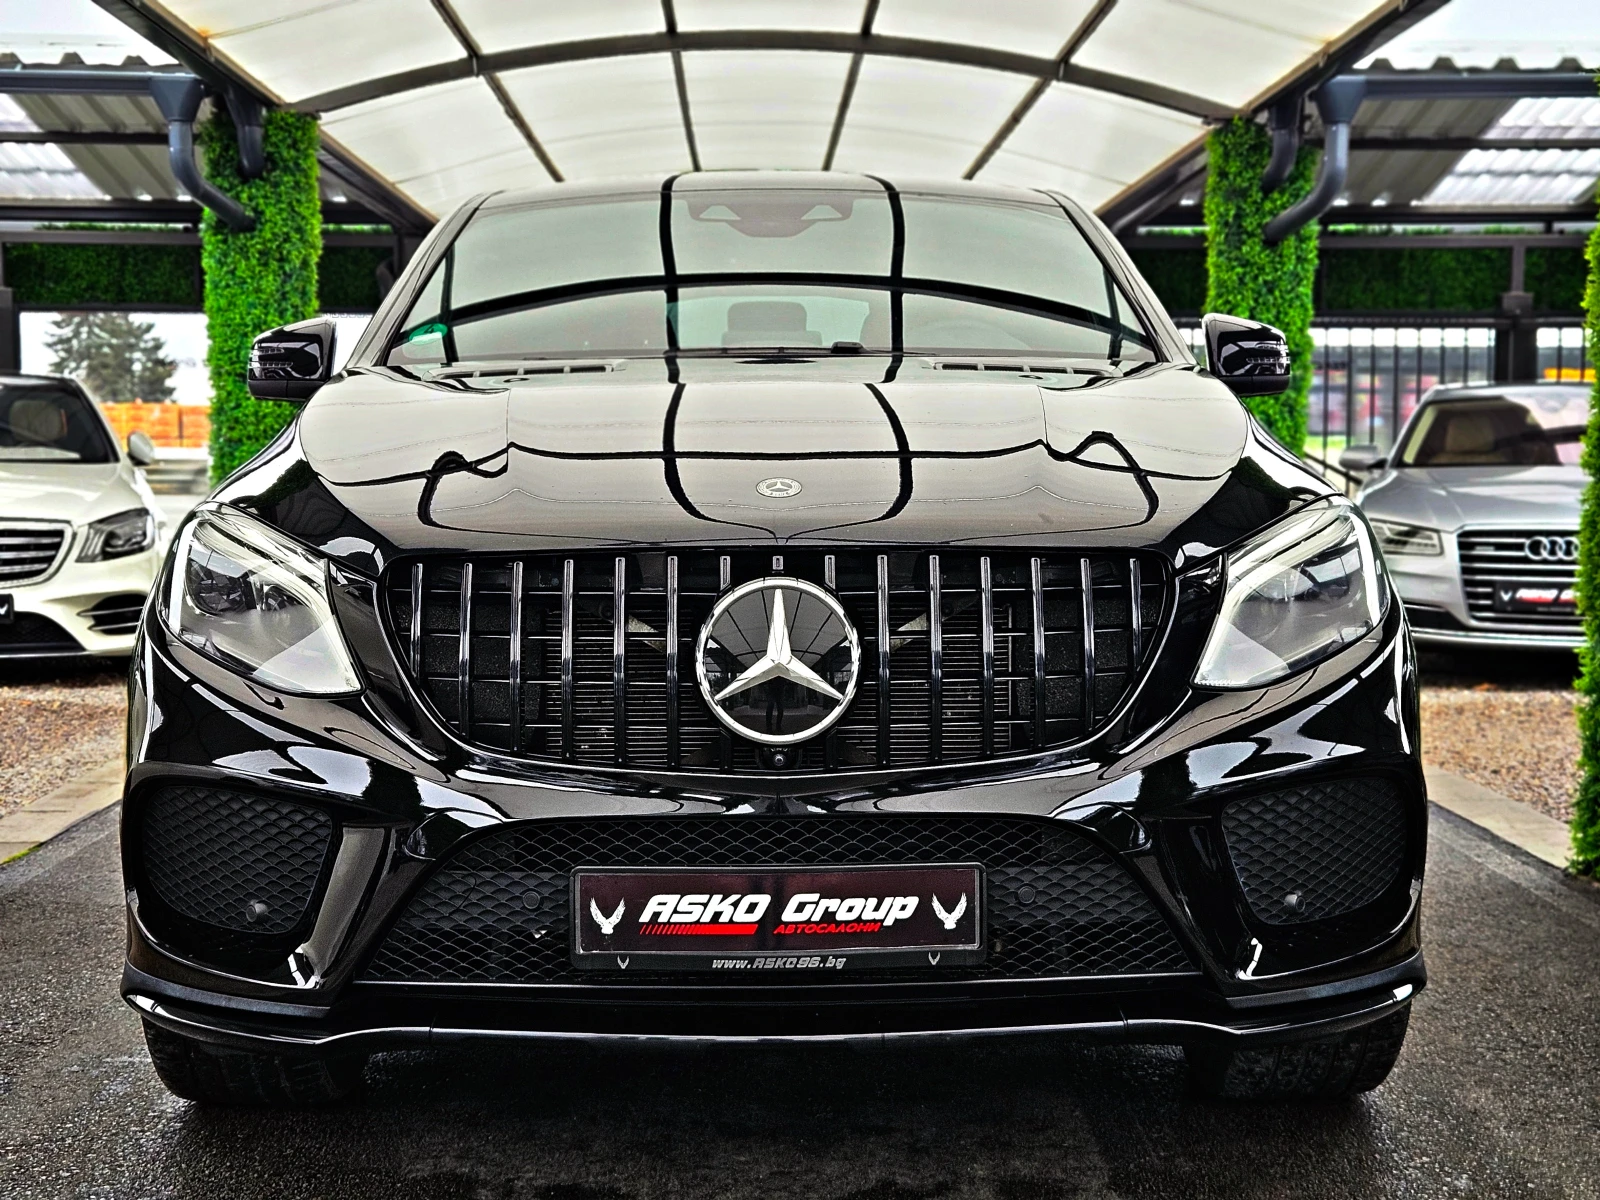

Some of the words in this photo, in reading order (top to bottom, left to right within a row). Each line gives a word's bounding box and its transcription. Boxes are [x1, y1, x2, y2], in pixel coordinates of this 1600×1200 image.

[639, 894, 772, 923] ASKO
[781, 893, 920, 926] Group
[773, 922, 882, 935] АВТОСАЛОНИ
[711, 956, 847, 970] www.ASKO96.bg
